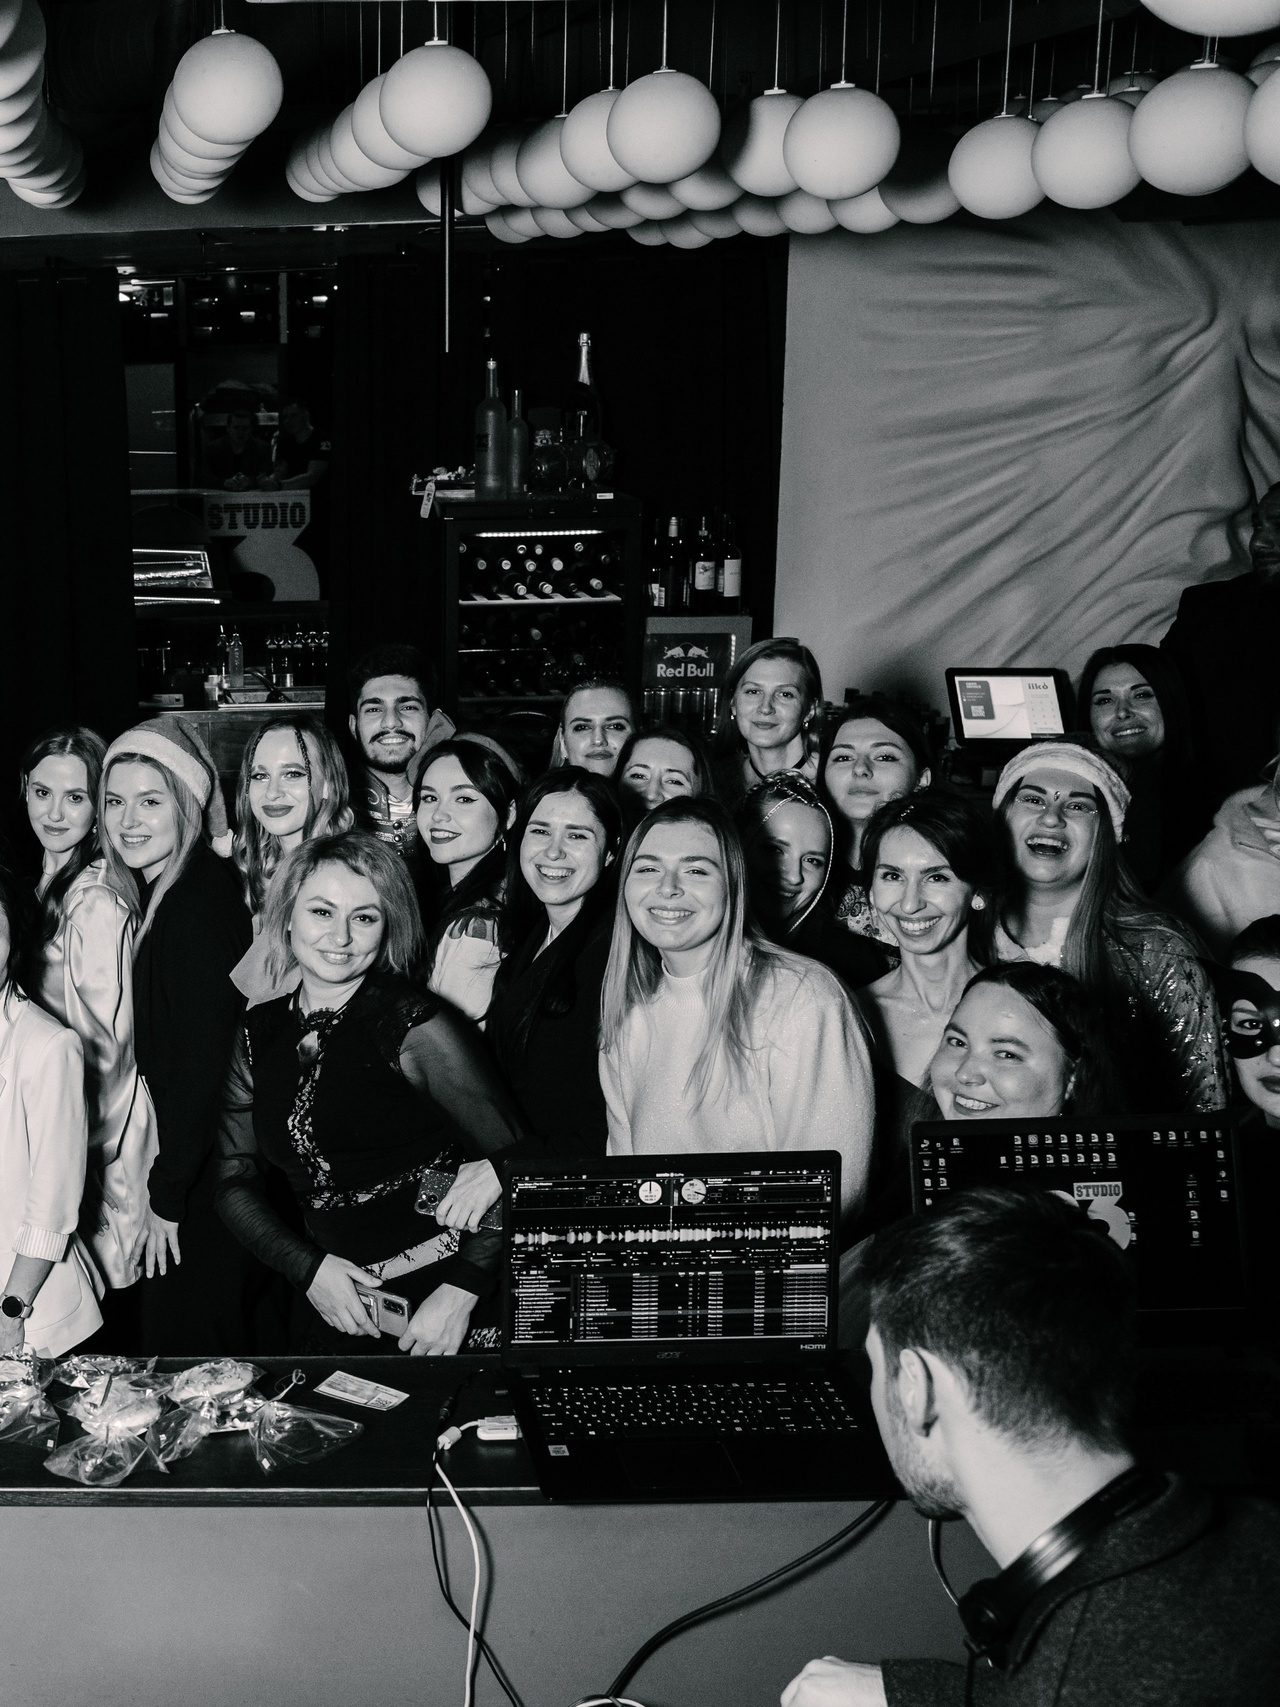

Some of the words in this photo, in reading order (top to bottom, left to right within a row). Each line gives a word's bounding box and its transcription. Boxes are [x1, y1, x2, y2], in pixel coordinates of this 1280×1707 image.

[207, 502, 307, 530] STUDIO
[656, 662, 685, 678] Red
[686, 662, 715, 678] Bull
[1075, 1183, 1121, 1198] STUDIO
